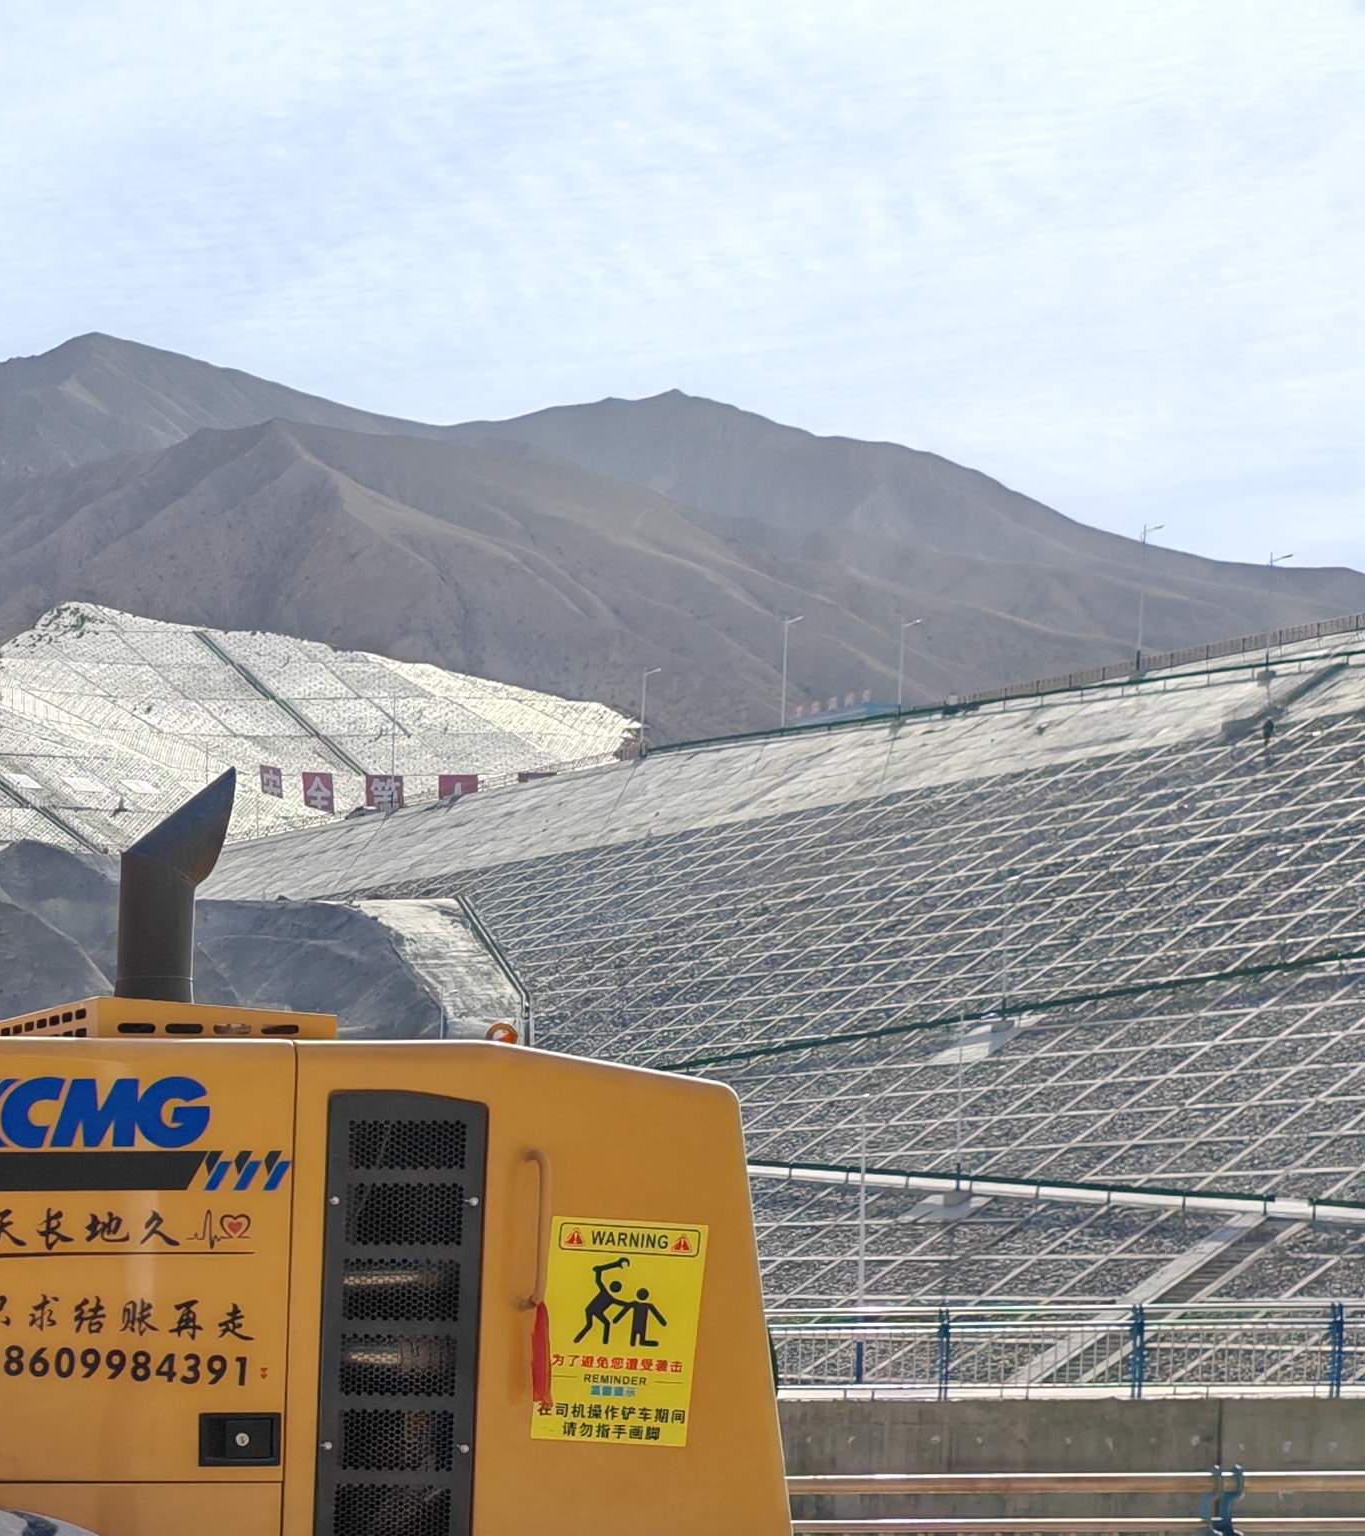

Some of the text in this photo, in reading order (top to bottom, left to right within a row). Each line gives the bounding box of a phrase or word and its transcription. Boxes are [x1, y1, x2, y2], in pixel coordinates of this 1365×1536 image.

[591, 1230, 669, 1250] WARNING
[583, 1373, 648, 1386] REMINDER
[562, 1421, 661, 1441] 请勿指手画脚
